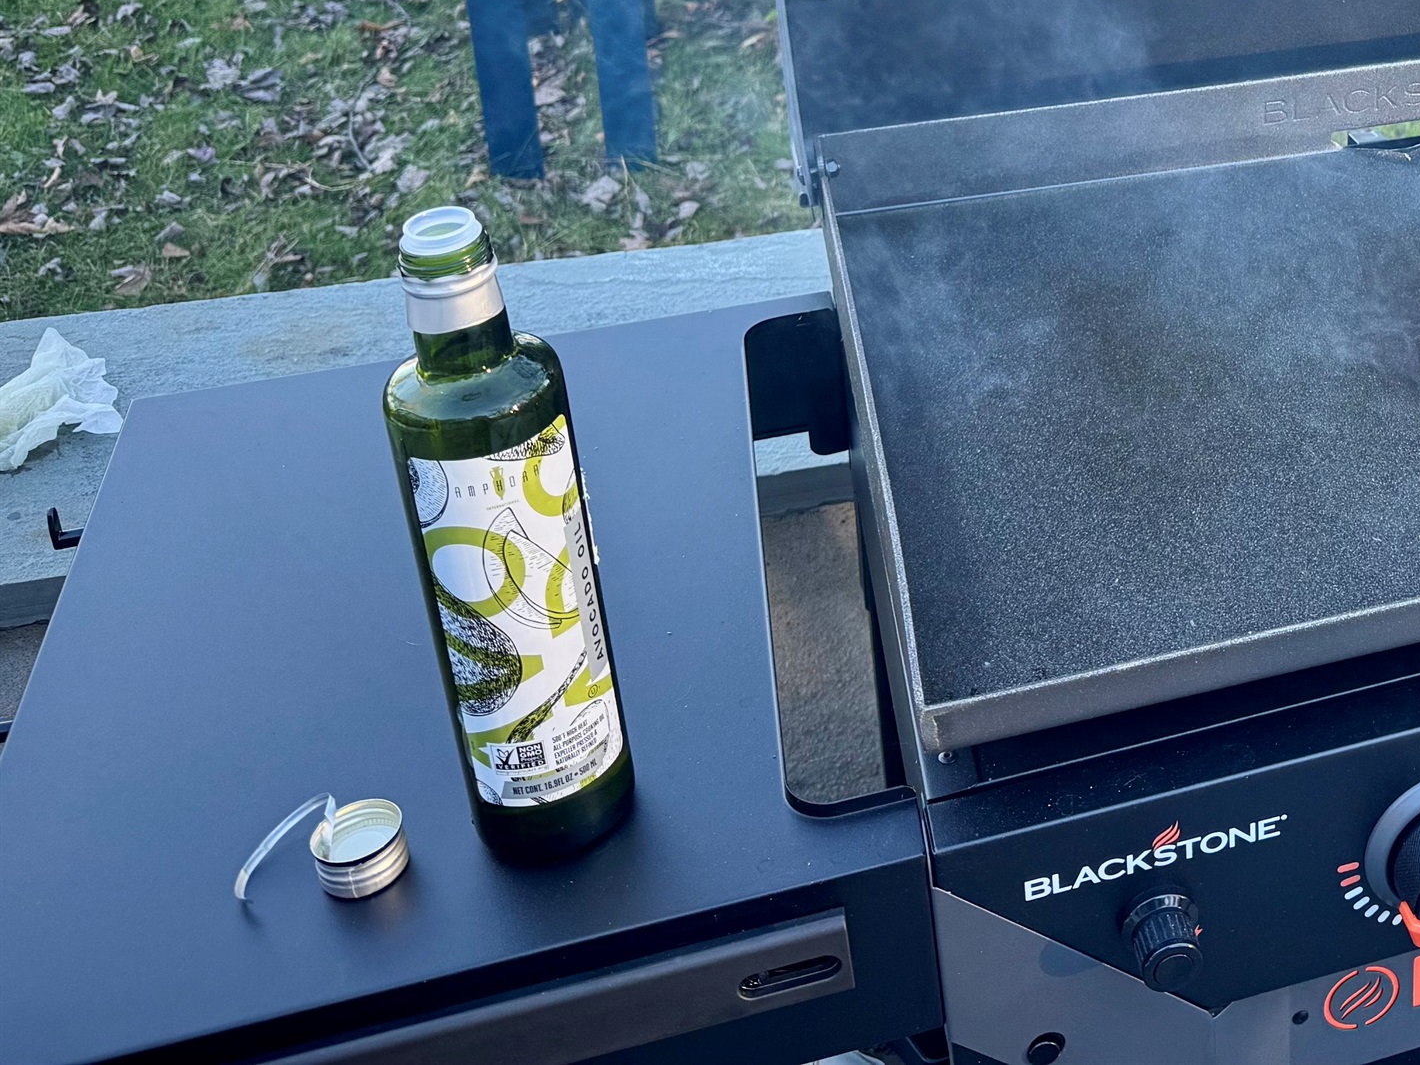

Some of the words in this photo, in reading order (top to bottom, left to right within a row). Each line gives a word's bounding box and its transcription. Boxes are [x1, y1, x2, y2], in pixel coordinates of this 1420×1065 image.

[573, 521, 585, 558] OIL
[581, 566, 604, 660] AVOCADO
[497, 761, 545, 770] VERIFIED
[519, 743, 541, 752] NON
[519, 750, 542, 758] GMO
[512, 786, 524, 795] NET
[525, 784, 544, 795] CONT.
[578, 764, 590, 777] 500
[590, 757, 598, 769] ML
[1023, 816, 1282, 902] BLACKSTONE
